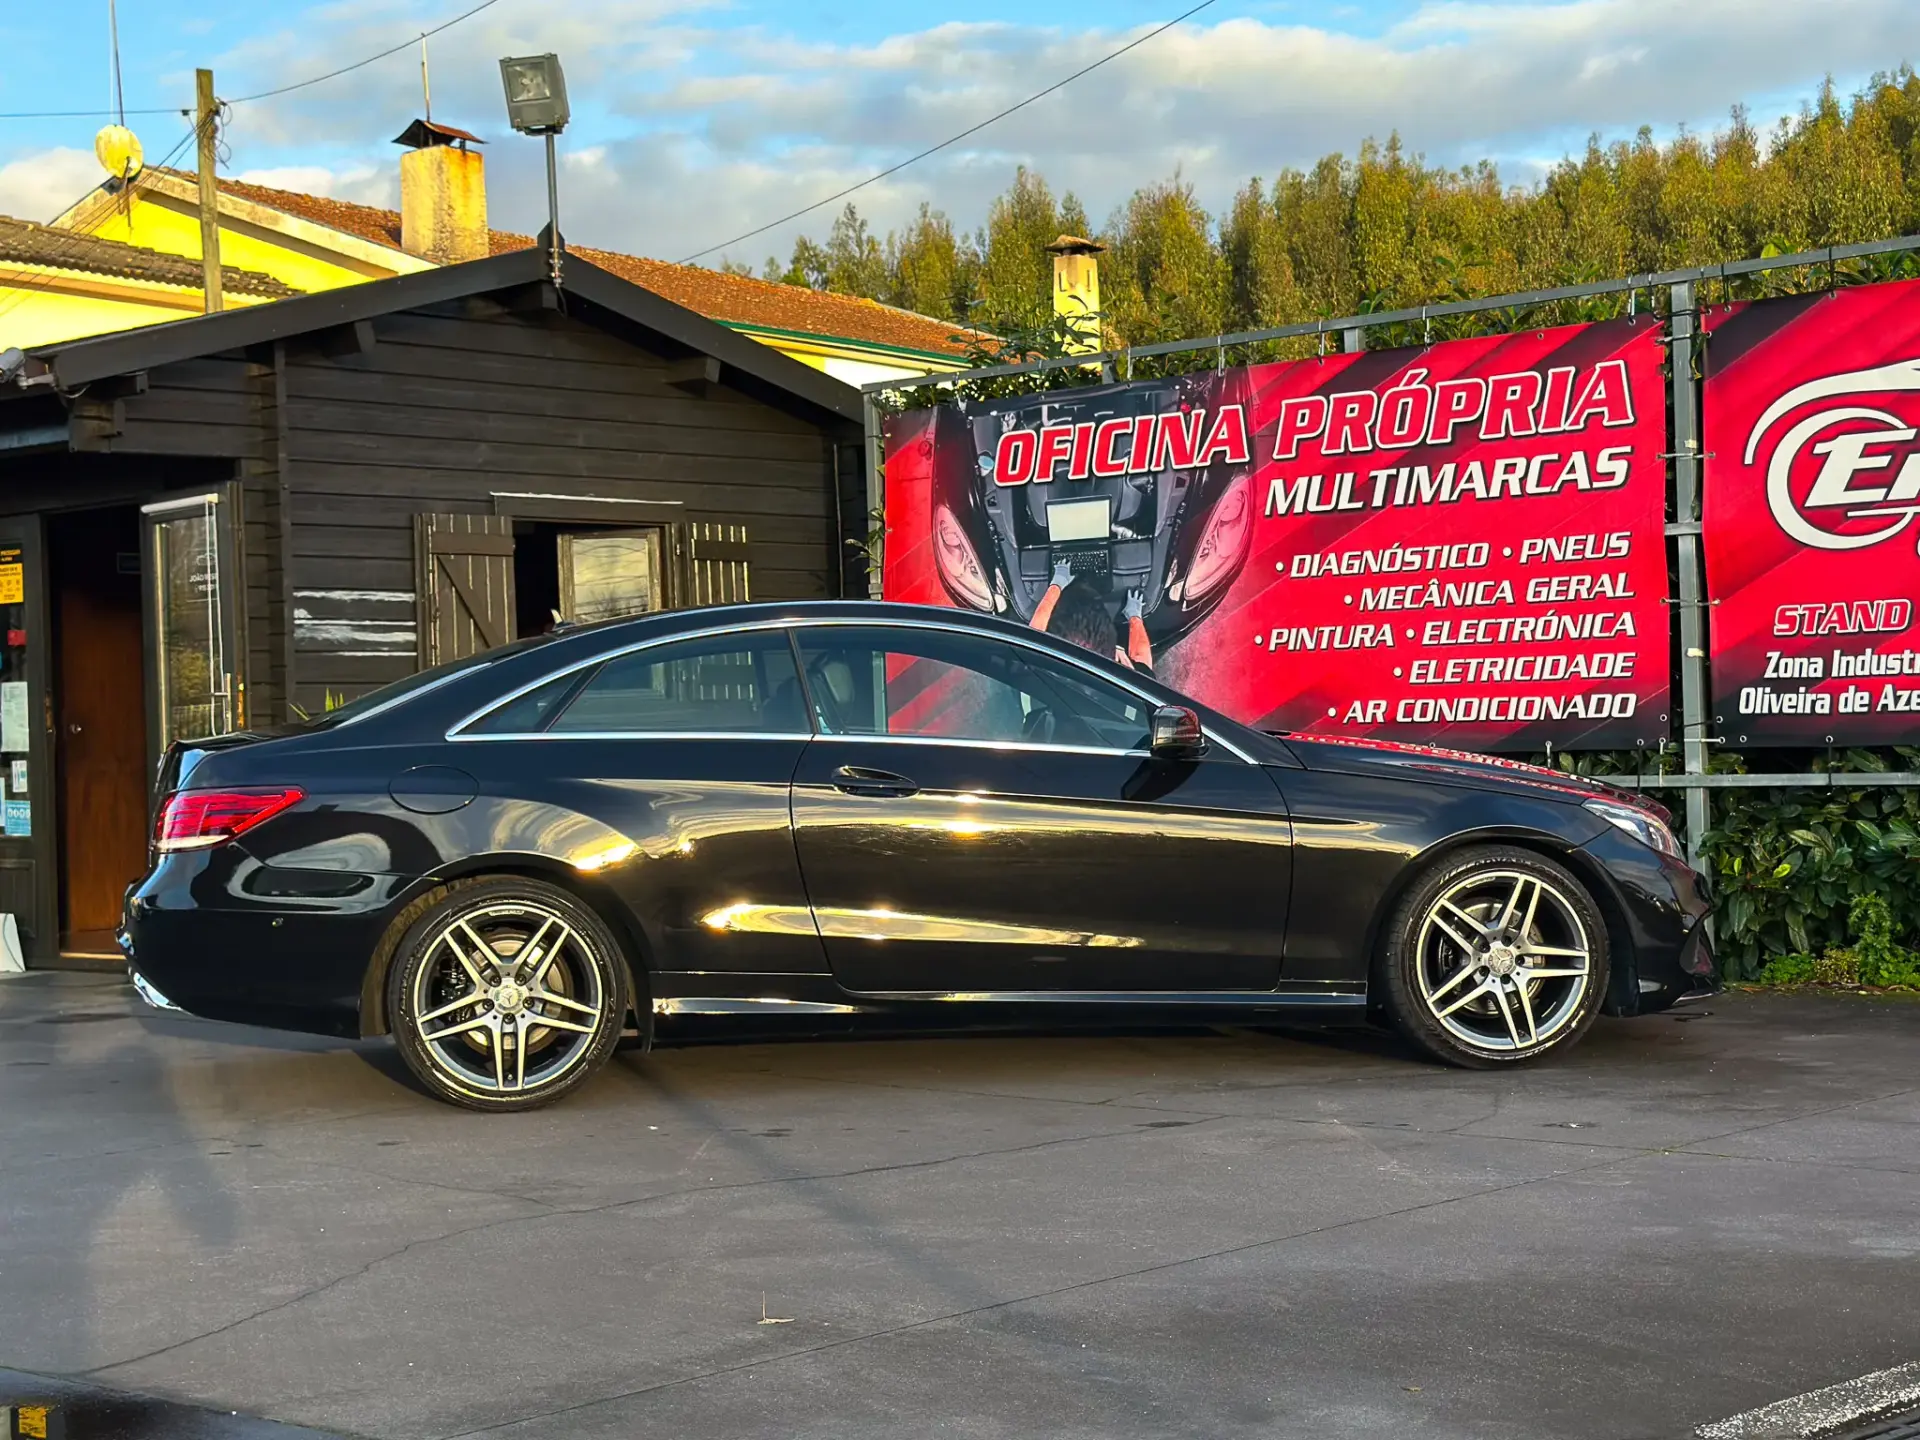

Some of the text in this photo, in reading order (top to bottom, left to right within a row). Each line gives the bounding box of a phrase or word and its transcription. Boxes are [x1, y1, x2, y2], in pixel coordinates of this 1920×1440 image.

[994, 360, 1634, 486] OFICINA PRÓPRIA
[1265, 446, 1632, 515] MULTIMARCAS
[1290, 531, 1631, 578] DIAGNÓSTICO PNEUS
[1359, 573, 1635, 611] MECÂNICA GERAL
[1268, 610, 1636, 651] PINTURA ELECTRÓNICA
[1774, 599, 1911, 635] STAND
[1409, 652, 1637, 685] ELETRICIDADE
[1764, 651, 1824, 679] Zona
[1343, 693, 1637, 724] AR CONDICIONADO
[1739, 686, 1831, 714] Oliveira
[1838, 685, 1870, 713] de
